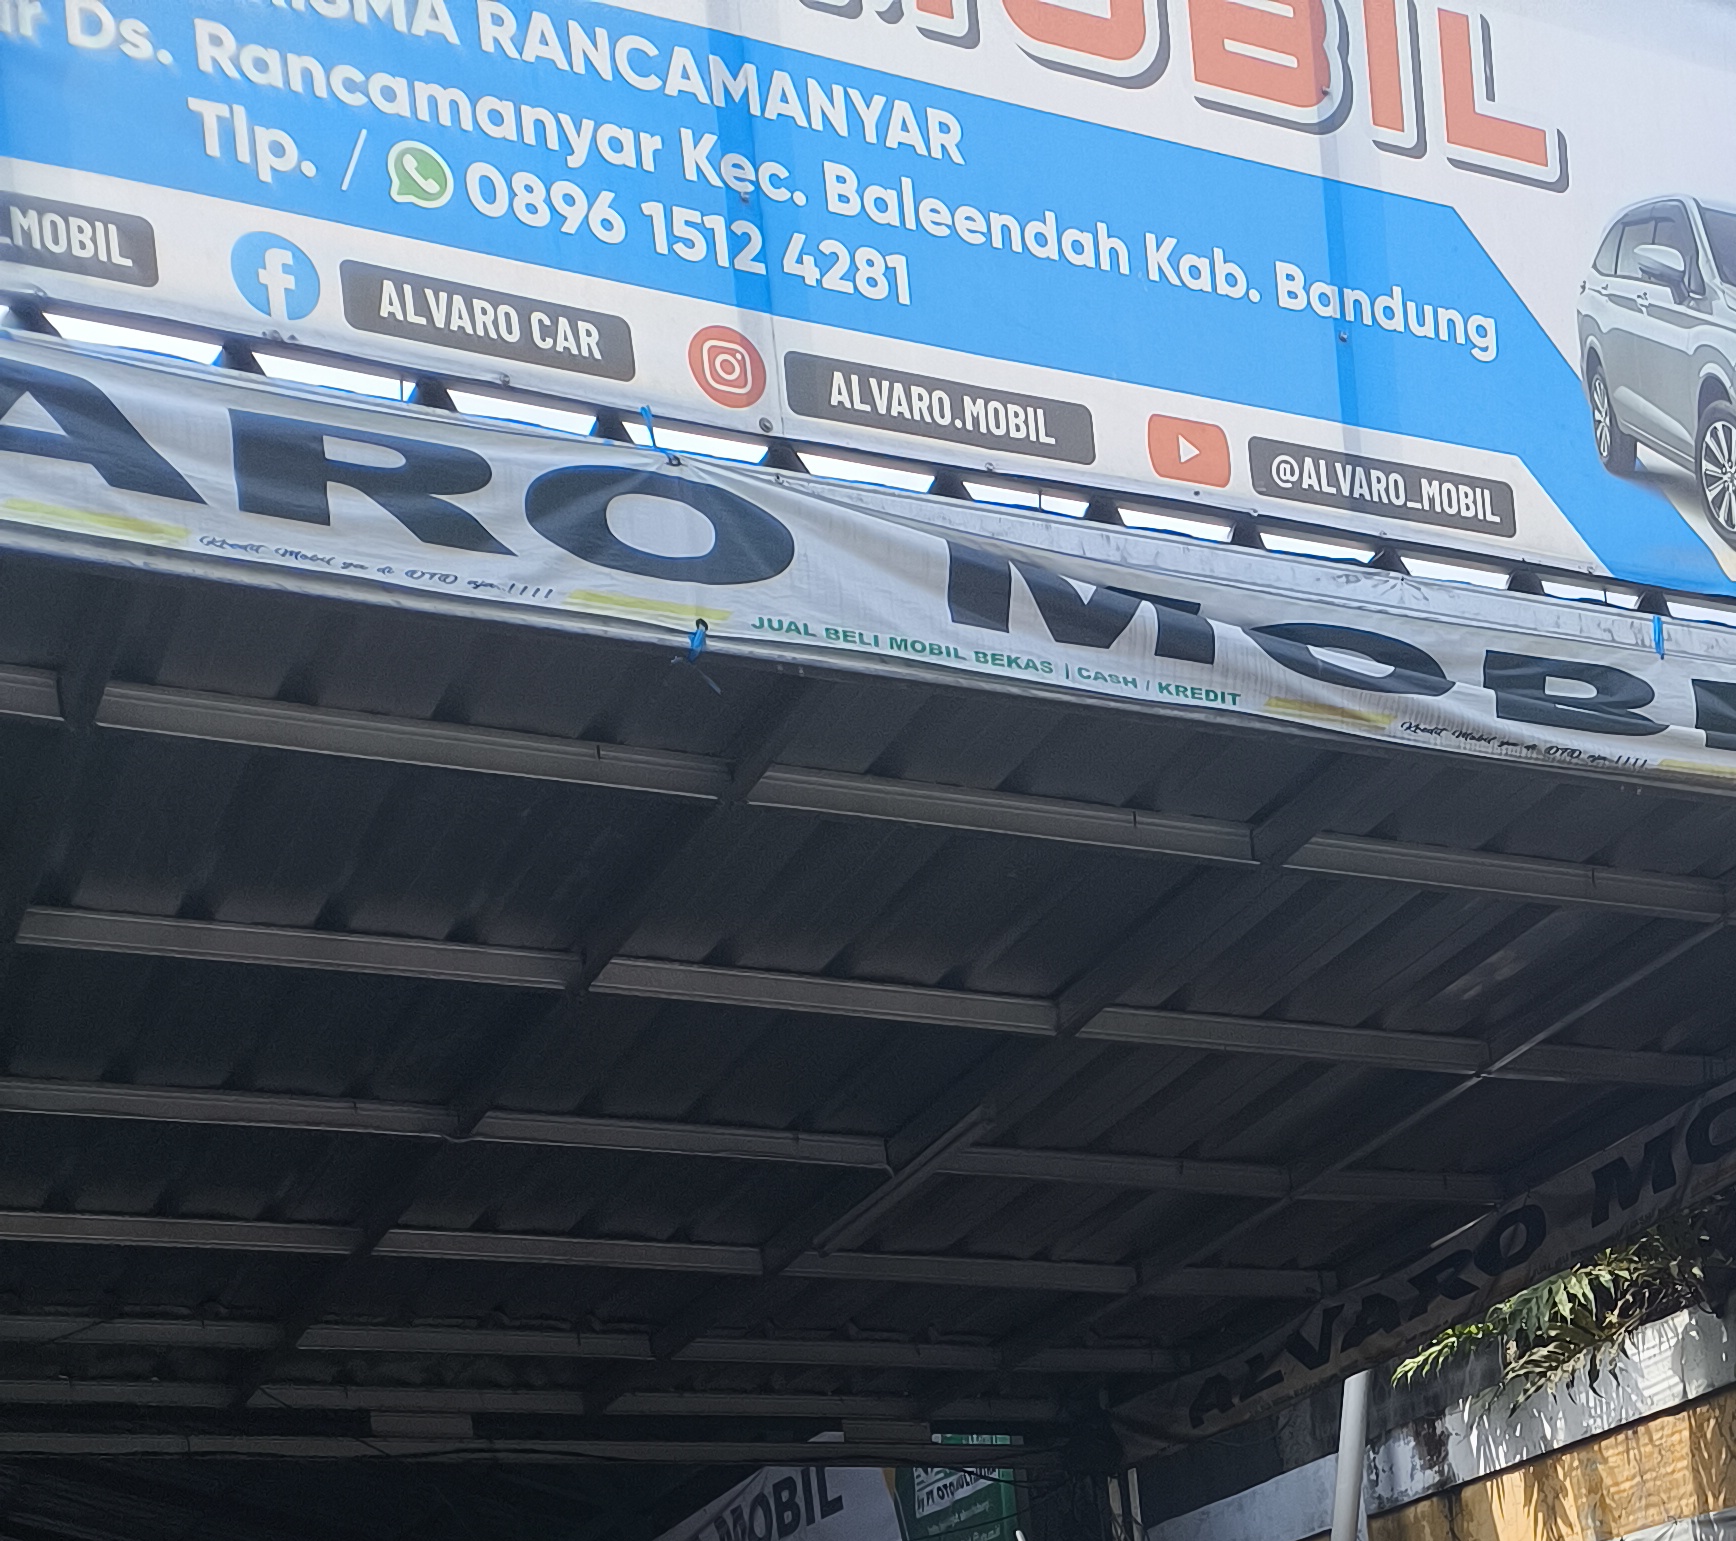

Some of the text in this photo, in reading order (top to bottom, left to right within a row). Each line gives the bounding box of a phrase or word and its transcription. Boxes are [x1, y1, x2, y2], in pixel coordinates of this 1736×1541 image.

[477, 0, 966, 165] RANCAMANYAR
[65, 0, 172, 65] Ds.
[194, 18, 663, 170] Rancamanyar
[680, 128, 808, 207] Kec.
[823, 160, 1130, 276] Baleendah
[1145, 231, 1262, 304] Kab.
[1275, 260, 1498, 362] Bandung
[187, 96, 317, 183] Tlp.
[466, 161, 627, 244] 0896
[641, 201, 767, 275] 1512
[784, 232, 911, 306] 4281
[380, 279, 602, 360] ALVARO CAR
[829, 369, 1056, 447] ALVARO.MOBIL
[1270, 454, 1501, 523] @ALVARO_MOBIL
[750, 615, 818, 638] JUAL
[823, 626, 880, 649] BELI
[888, 636, 967, 662] MOBIL
[973, 650, 1054, 675] BEKAS
[1077, 667, 1138, 690] CASH
[1157, 681, 1241, 706] KREDIT
[1189, 1204, 1547, 1430] ALVARO
